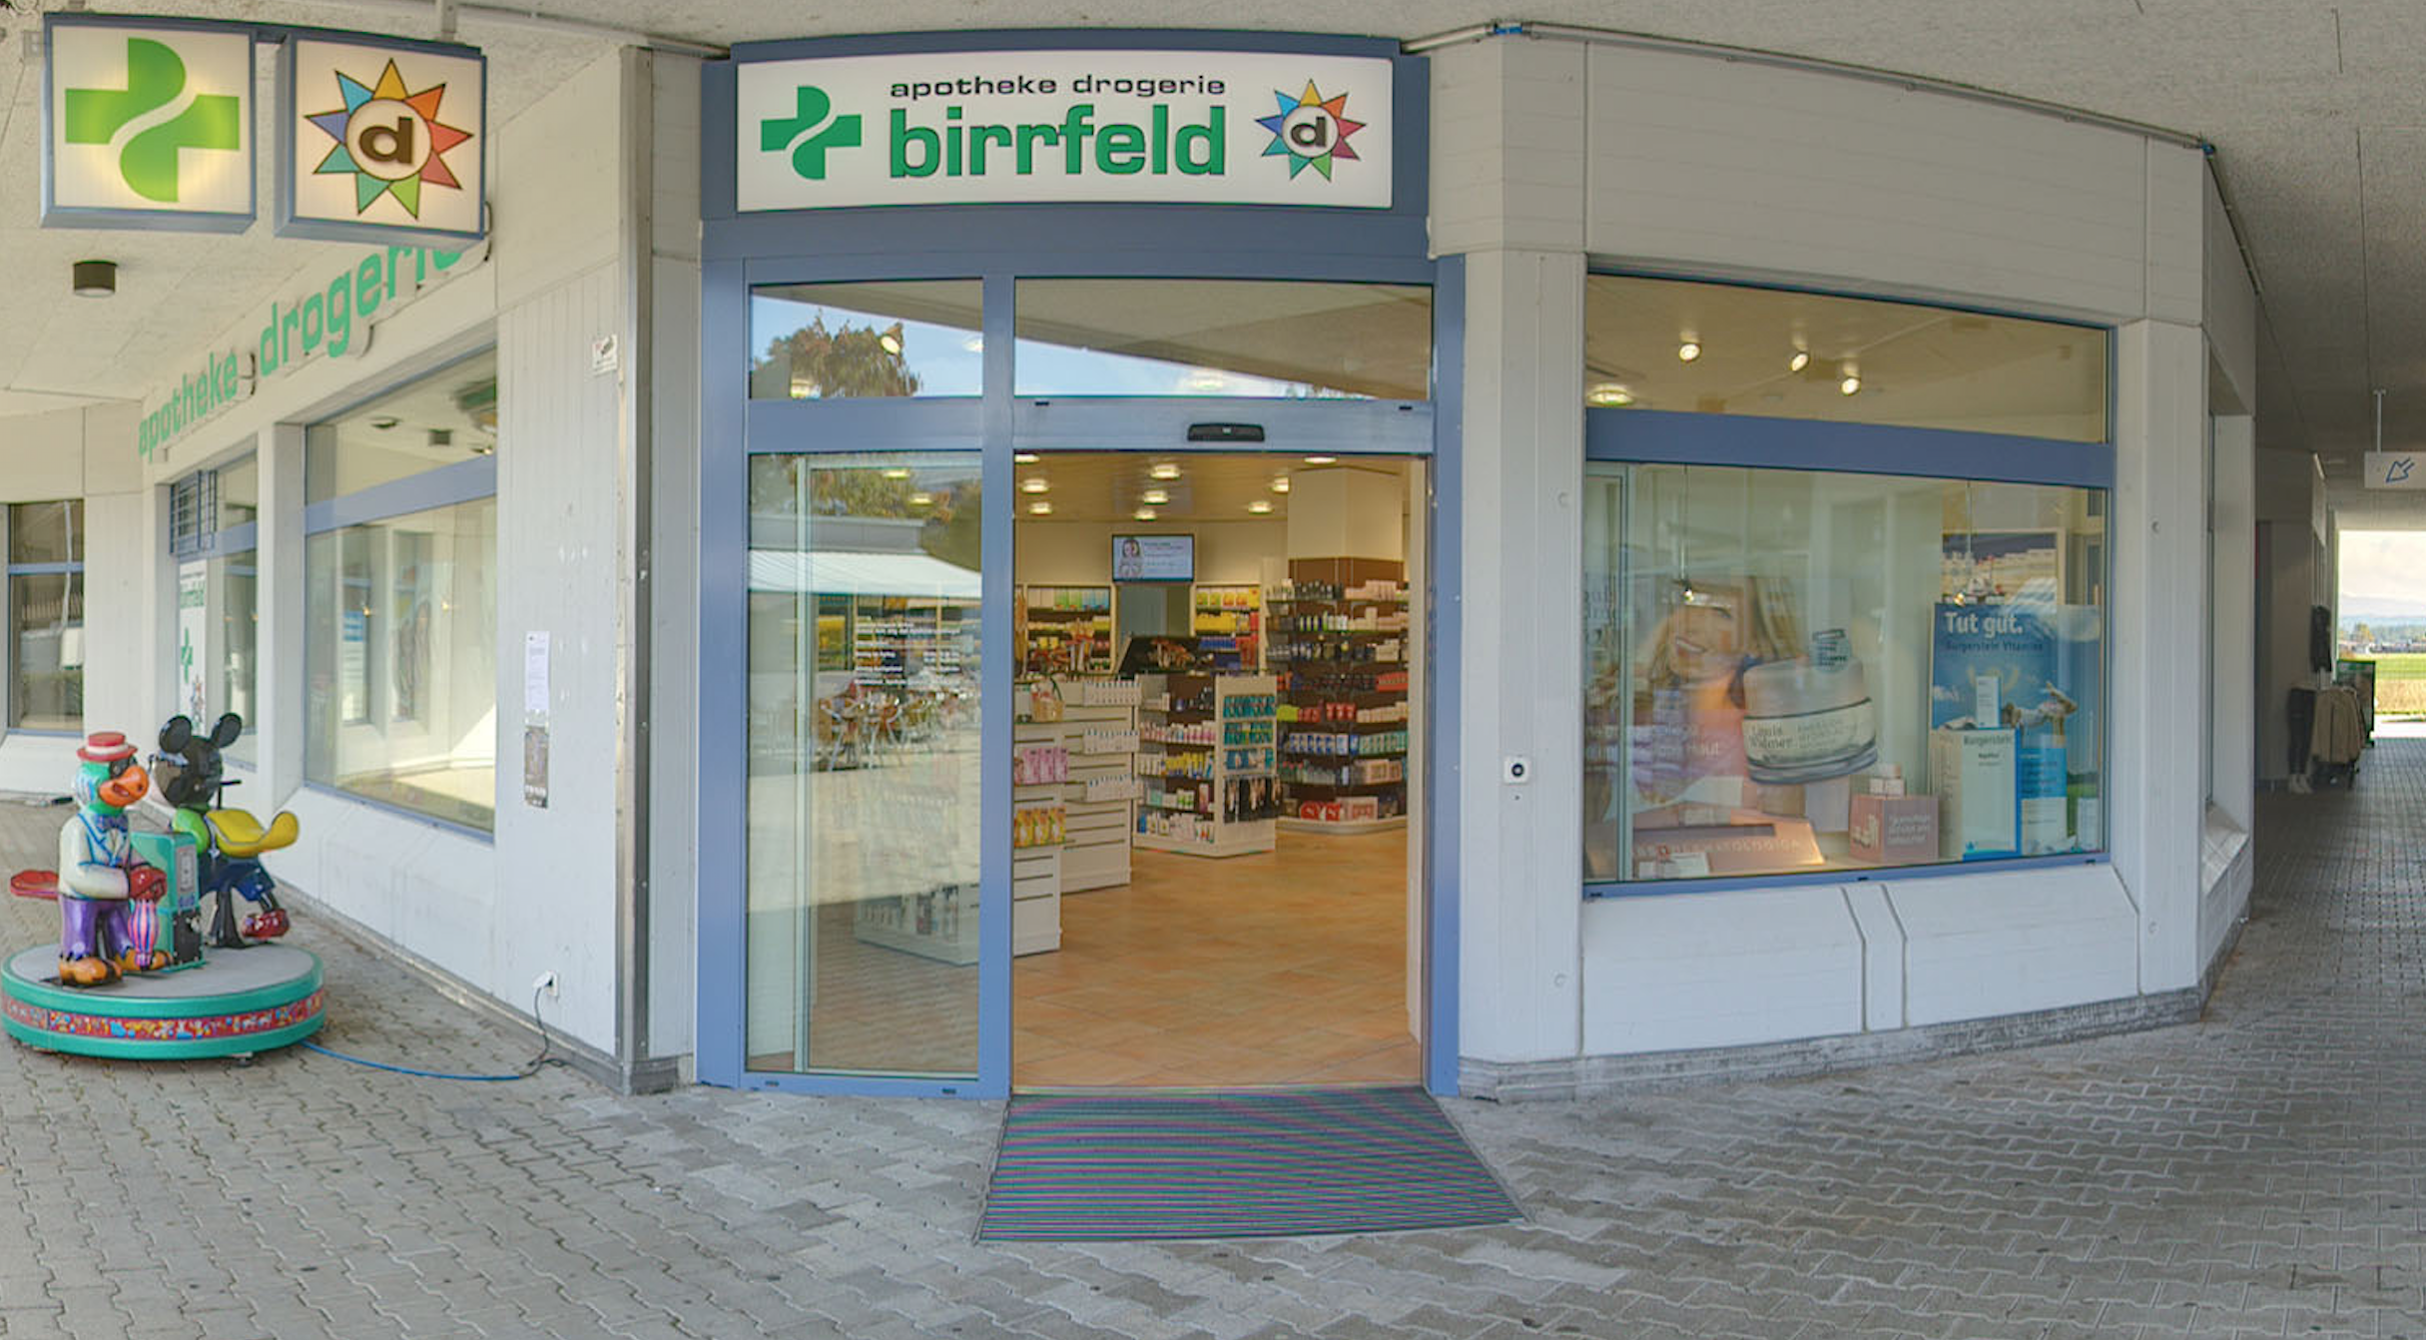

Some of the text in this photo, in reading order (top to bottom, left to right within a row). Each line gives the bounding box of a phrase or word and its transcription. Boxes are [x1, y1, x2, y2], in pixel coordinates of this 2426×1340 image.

[891, 75, 1226, 100] apotheke drogerie
[359, 116, 413, 164] d
[889, 104, 1226, 178] birrfeld
[1290, 116, 1327, 148] d
[138, 351, 238, 464] apotheke
[1945, 612, 2023, 638] Tut gut.
